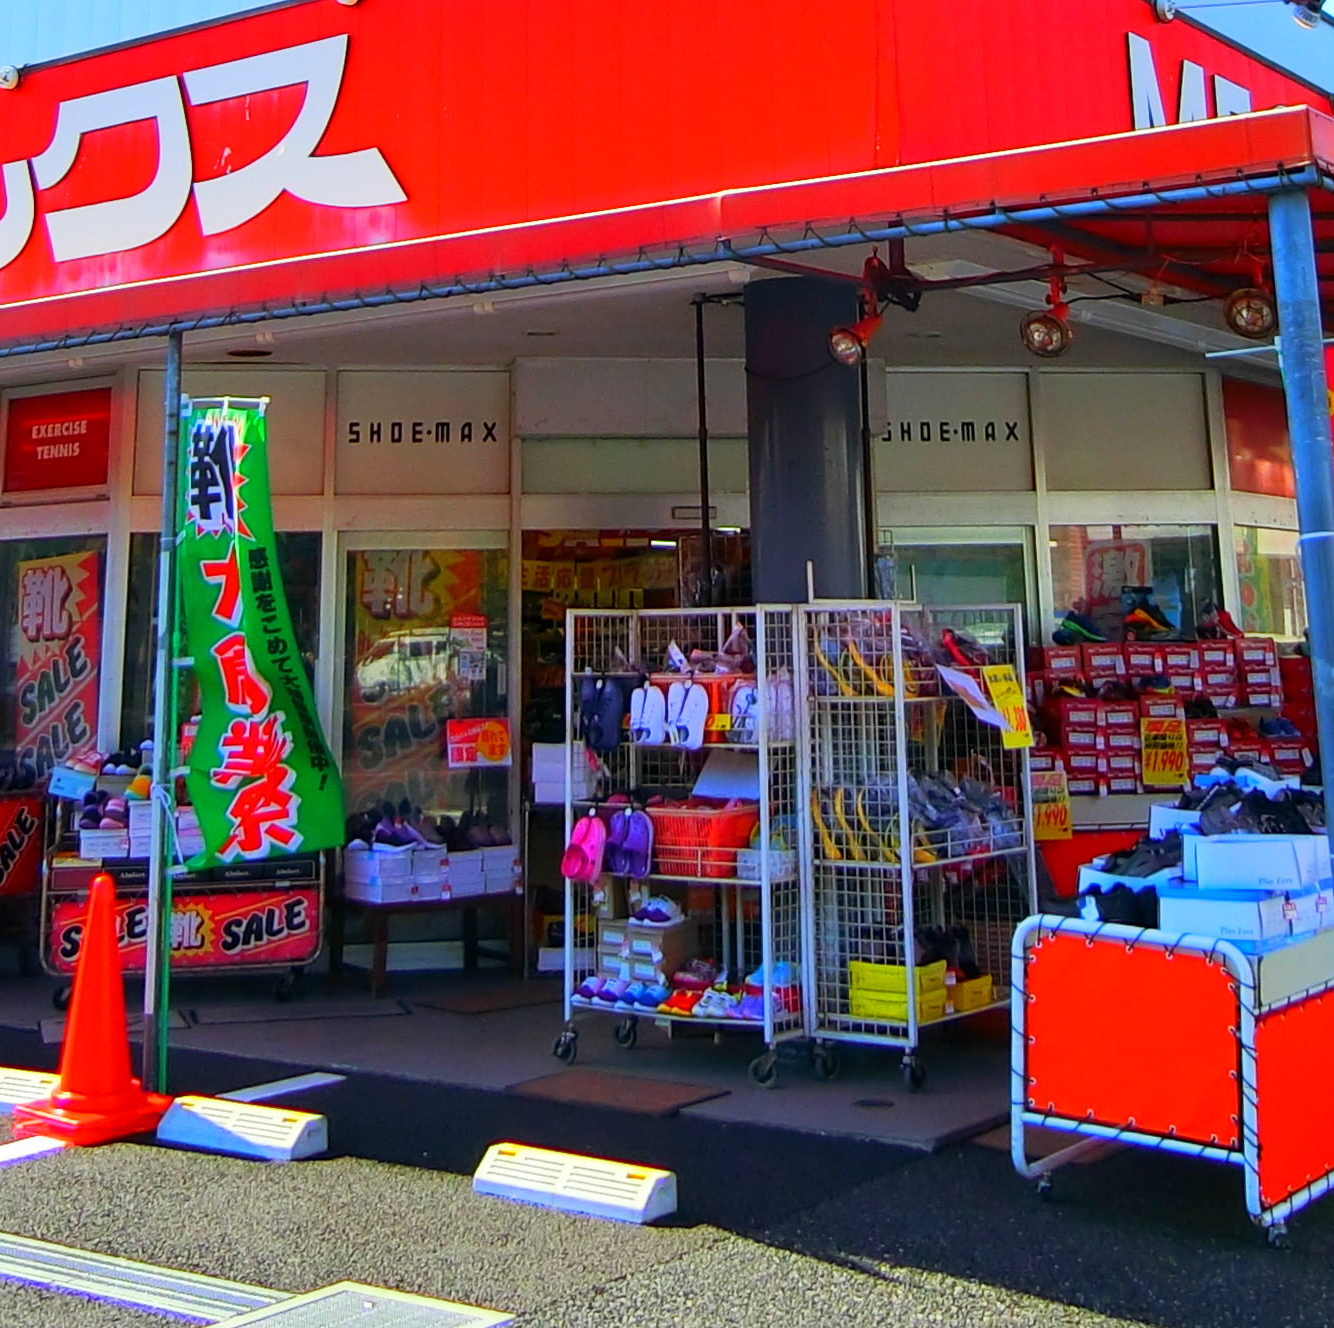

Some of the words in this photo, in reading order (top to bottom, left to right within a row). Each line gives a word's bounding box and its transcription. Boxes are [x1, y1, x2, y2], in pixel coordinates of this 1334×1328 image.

[31, 420, 87, 440] EXERCISE
[36, 442, 80, 460] TENNIS
[22, 565, 74, 643] 靴
[20, 635, 90, 726] SALE
[59, 904, 148, 961] SLE
[219, 896, 308, 954] SALE
